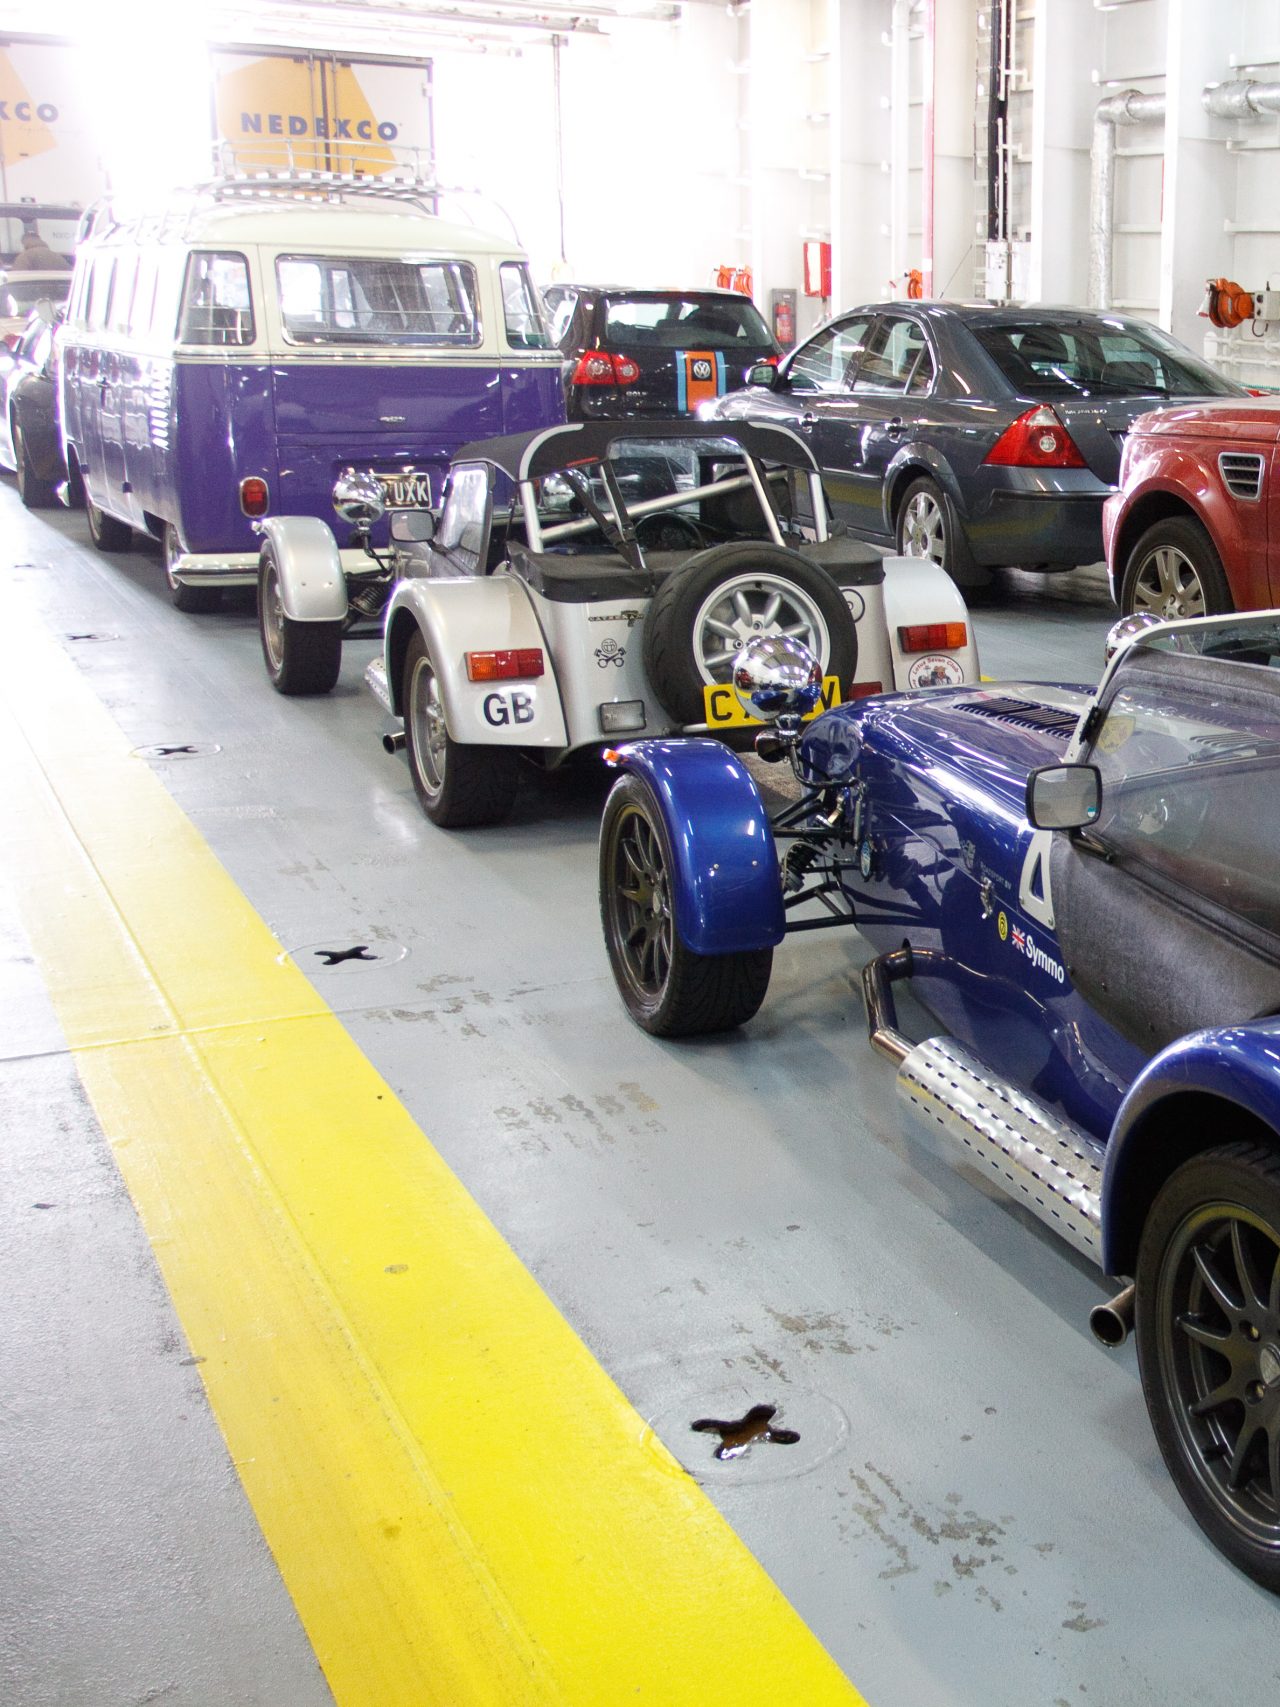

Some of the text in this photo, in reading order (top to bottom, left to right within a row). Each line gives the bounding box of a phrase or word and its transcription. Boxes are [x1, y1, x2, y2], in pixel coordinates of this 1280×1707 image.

[241, 112, 398, 141] NEDEXCO
[394, 481, 429, 503] UXK
[483, 692, 535, 727] GB
[1026, 935, 1065, 983] Symmo
